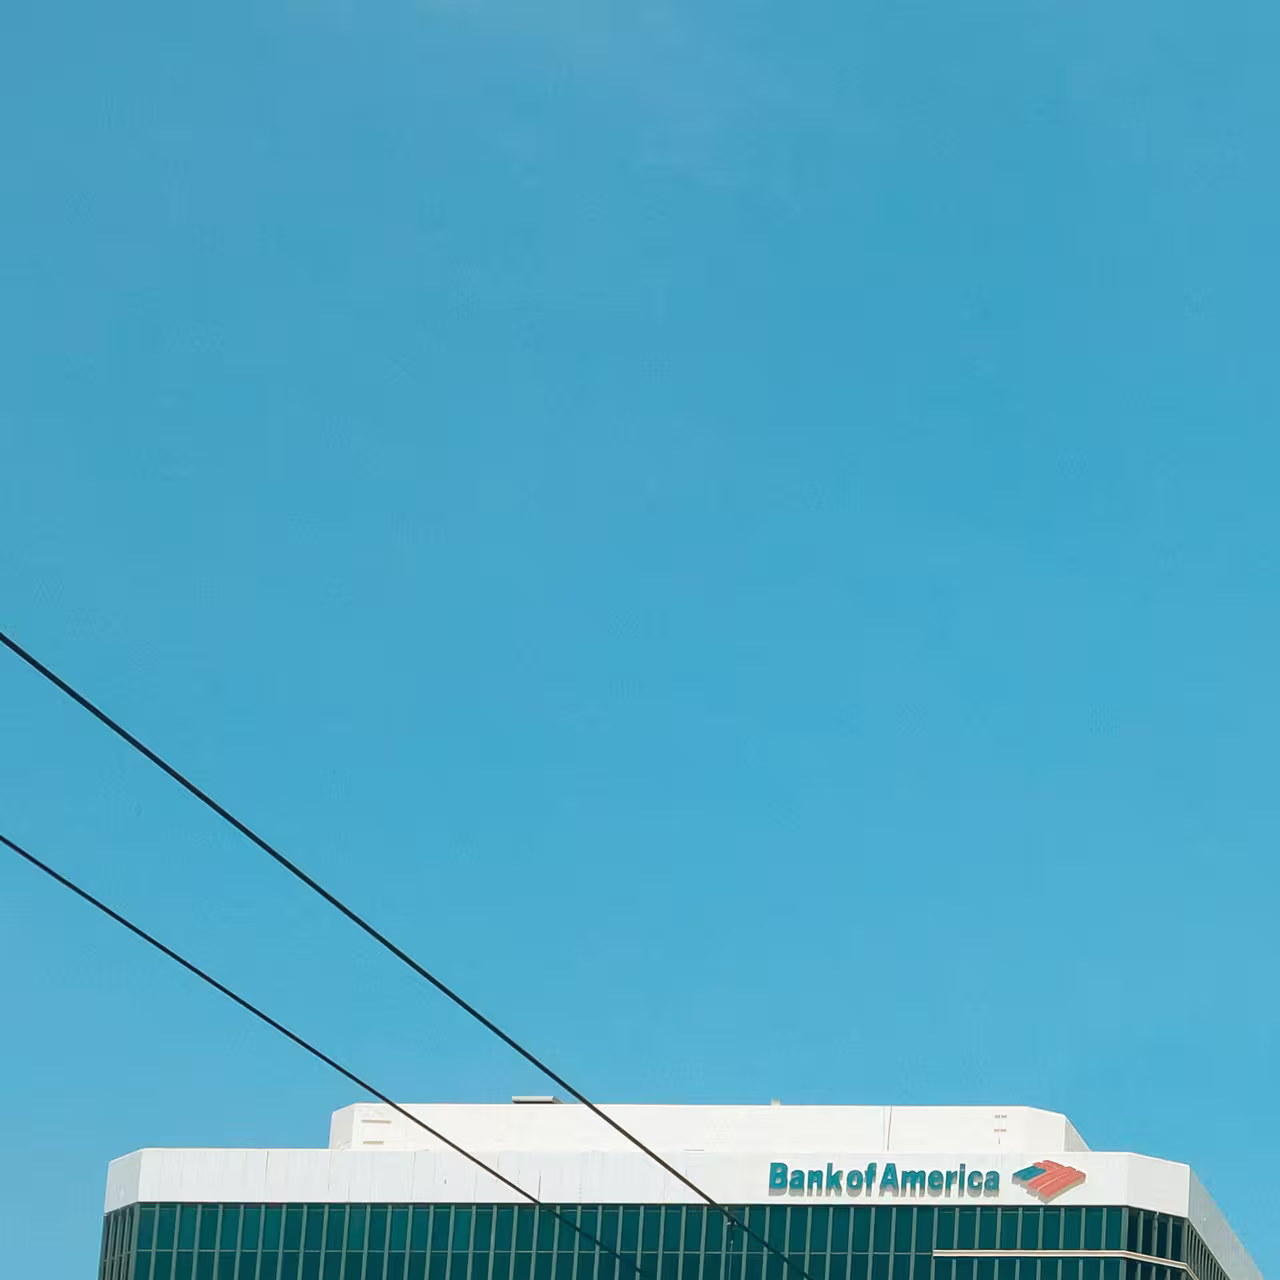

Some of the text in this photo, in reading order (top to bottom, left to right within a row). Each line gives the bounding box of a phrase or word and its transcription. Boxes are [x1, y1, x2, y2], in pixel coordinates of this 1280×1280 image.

[769, 1162, 1000, 1191] Bank of America
